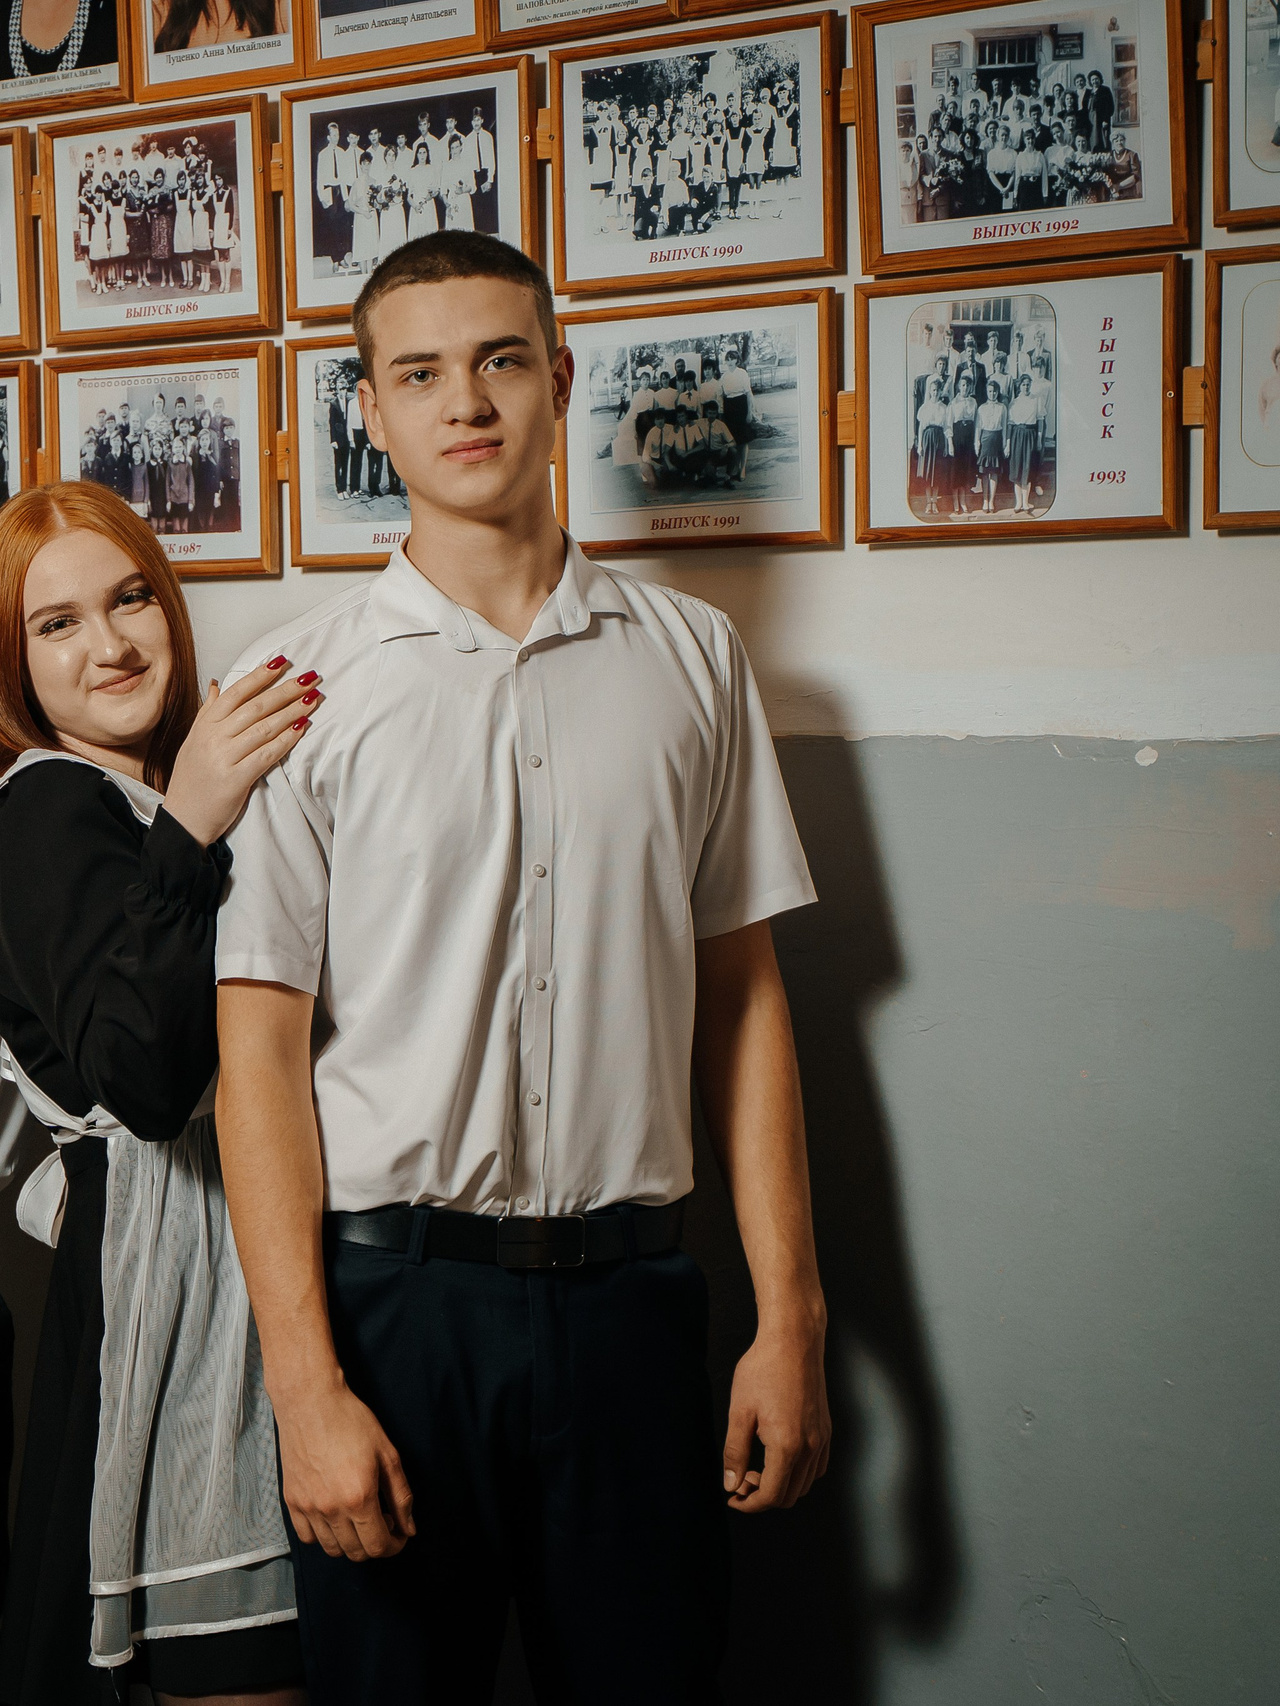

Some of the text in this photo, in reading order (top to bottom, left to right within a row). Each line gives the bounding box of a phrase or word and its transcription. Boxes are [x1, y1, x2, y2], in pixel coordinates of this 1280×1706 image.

[516, 0, 569, 11] ШАПОВАЛО
[582, 5, 603, 15] первой
[334, 8, 458, 36] Дымченко Александр Анатольевич
[166, 39, 282, 65] Луценко Анна Михайловна
[972, 219, 1079, 240] ВЫПУСК 1992
[648, 244, 743, 264] ВЫПУСК 1990
[125, 301, 199, 318] ВЫПУСК 1986
[1098, 317, 1117, 439] ВЫПУСК
[1088, 470, 1126, 485] 1993
[650, 515, 740, 531] ВЫПУСК 1991
[372, 532, 406, 544] ВЫП
[178, 542, 201, 556] 1987
